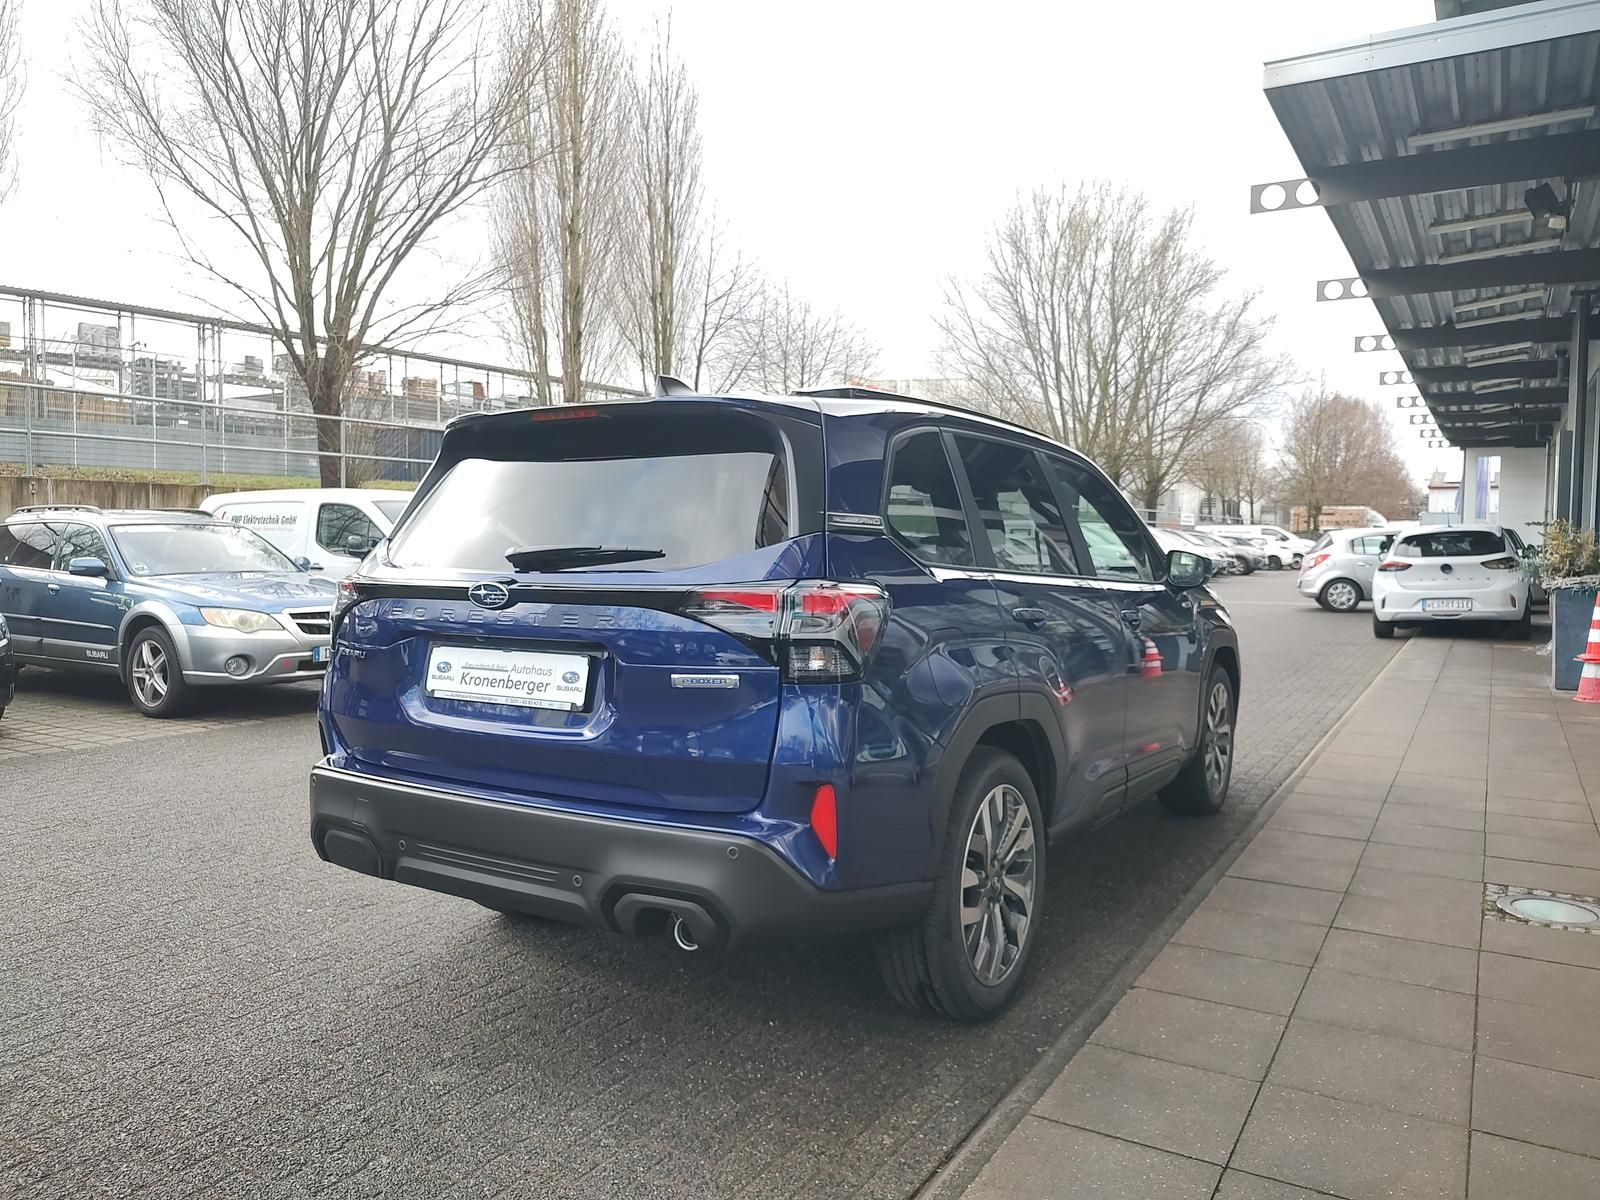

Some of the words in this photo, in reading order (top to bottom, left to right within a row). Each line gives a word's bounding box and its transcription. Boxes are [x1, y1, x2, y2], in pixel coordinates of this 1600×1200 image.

[243, 515, 280, 525] Elektrotechnik
[281, 515, 297, 525] GmbH
[387, 606, 616, 629] FORESTER
[86, 649, 109, 659] SUBARU
[510, 663, 553, 677] Autohaus
[431, 674, 455, 682] SUBARU
[459, 671, 551, 695] Kronenberger
[556, 684, 583, 693] SUBARU
